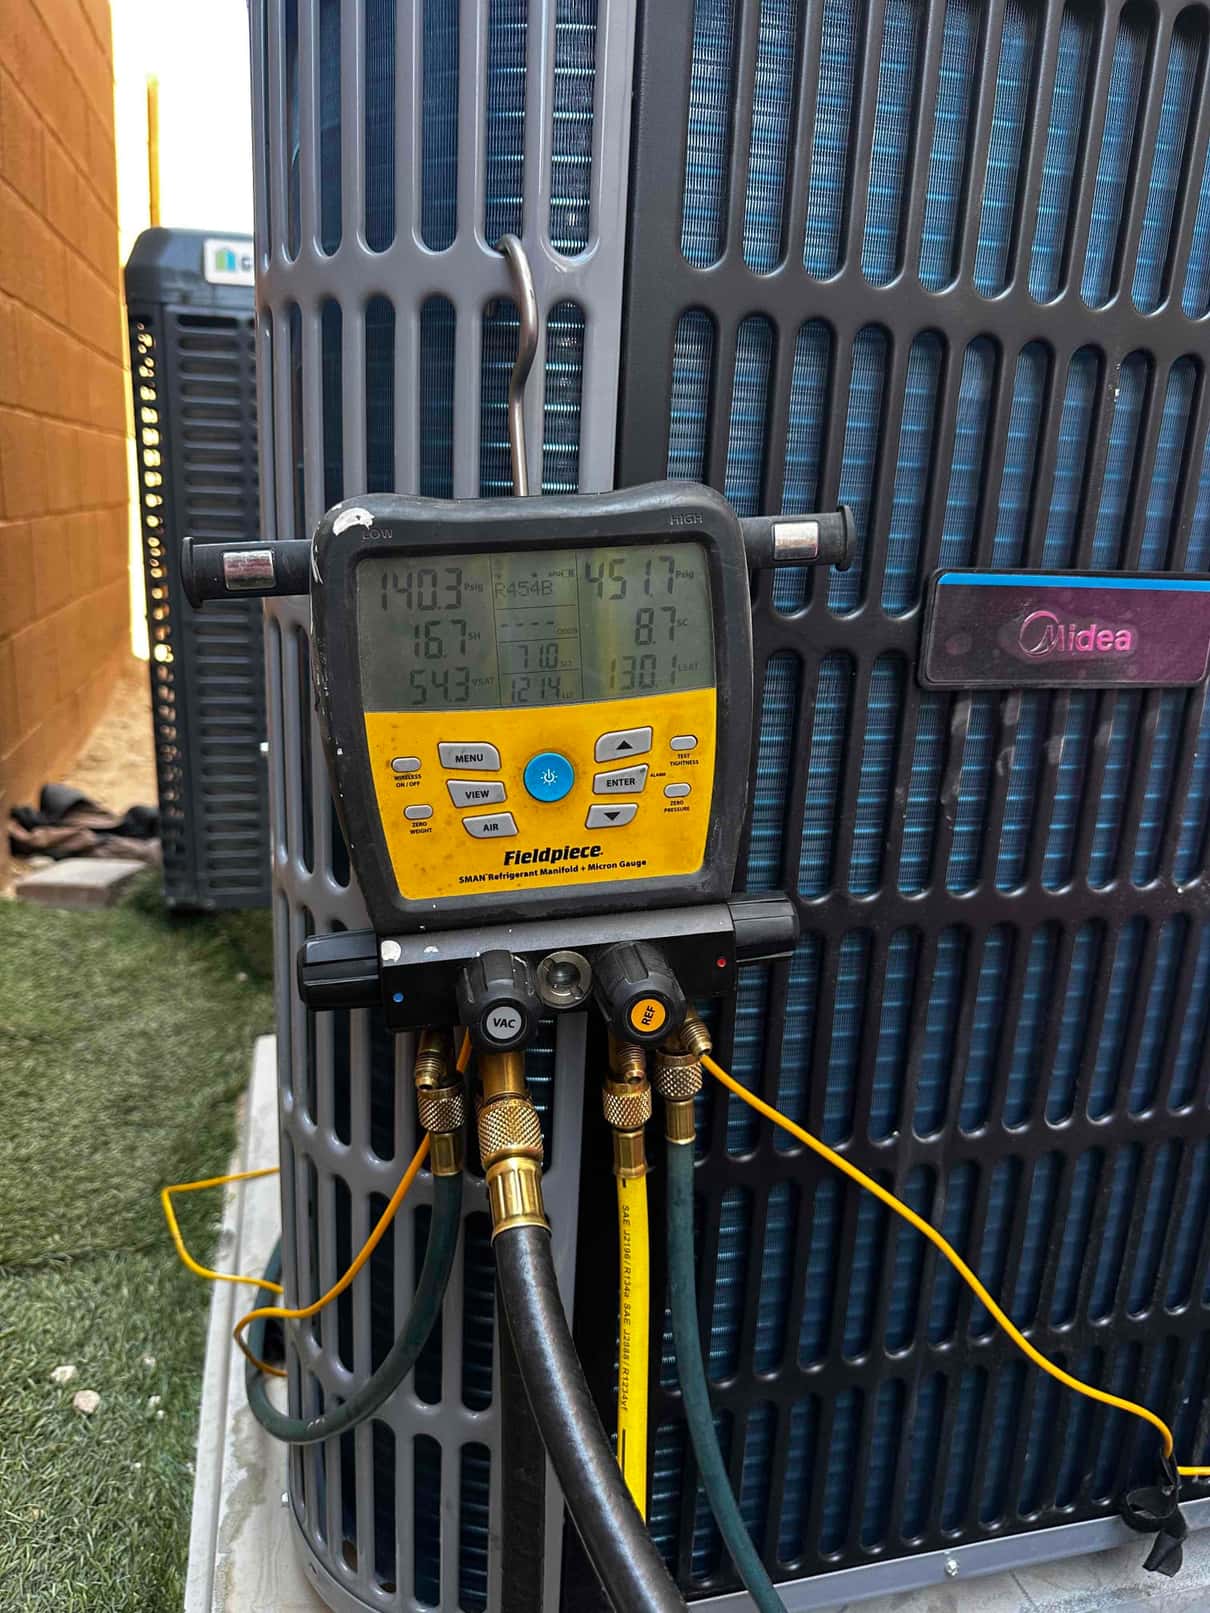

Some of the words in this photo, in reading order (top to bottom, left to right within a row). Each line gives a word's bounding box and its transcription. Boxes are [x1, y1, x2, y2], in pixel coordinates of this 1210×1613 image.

[670, 512, 704, 526] HIGH
[362, 528, 393, 540] LOW
[382, 567, 462, 611] 140.3
[495, 580, 553, 599] R454B
[1018, 610, 1132, 657] Midea
[455, 754, 484, 763] MENU
[606, 778, 636, 787] ENTER
[465, 790, 490, 799] VIEW
[483, 823, 499, 832] AIR
[503, 845, 602, 866] Fieldpiece
[488, 869, 539, 881] Refrigerant
[540, 865, 579, 876] Manifold
[588, 862, 618, 871] Micron
[619, 860, 647, 869] Gauge
[493, 1017, 516, 1029] VAC
[641, 1005, 655, 1026] REF
[623, 1205, 631, 1226] SAE
[623, 1303, 631, 1326] SAE
